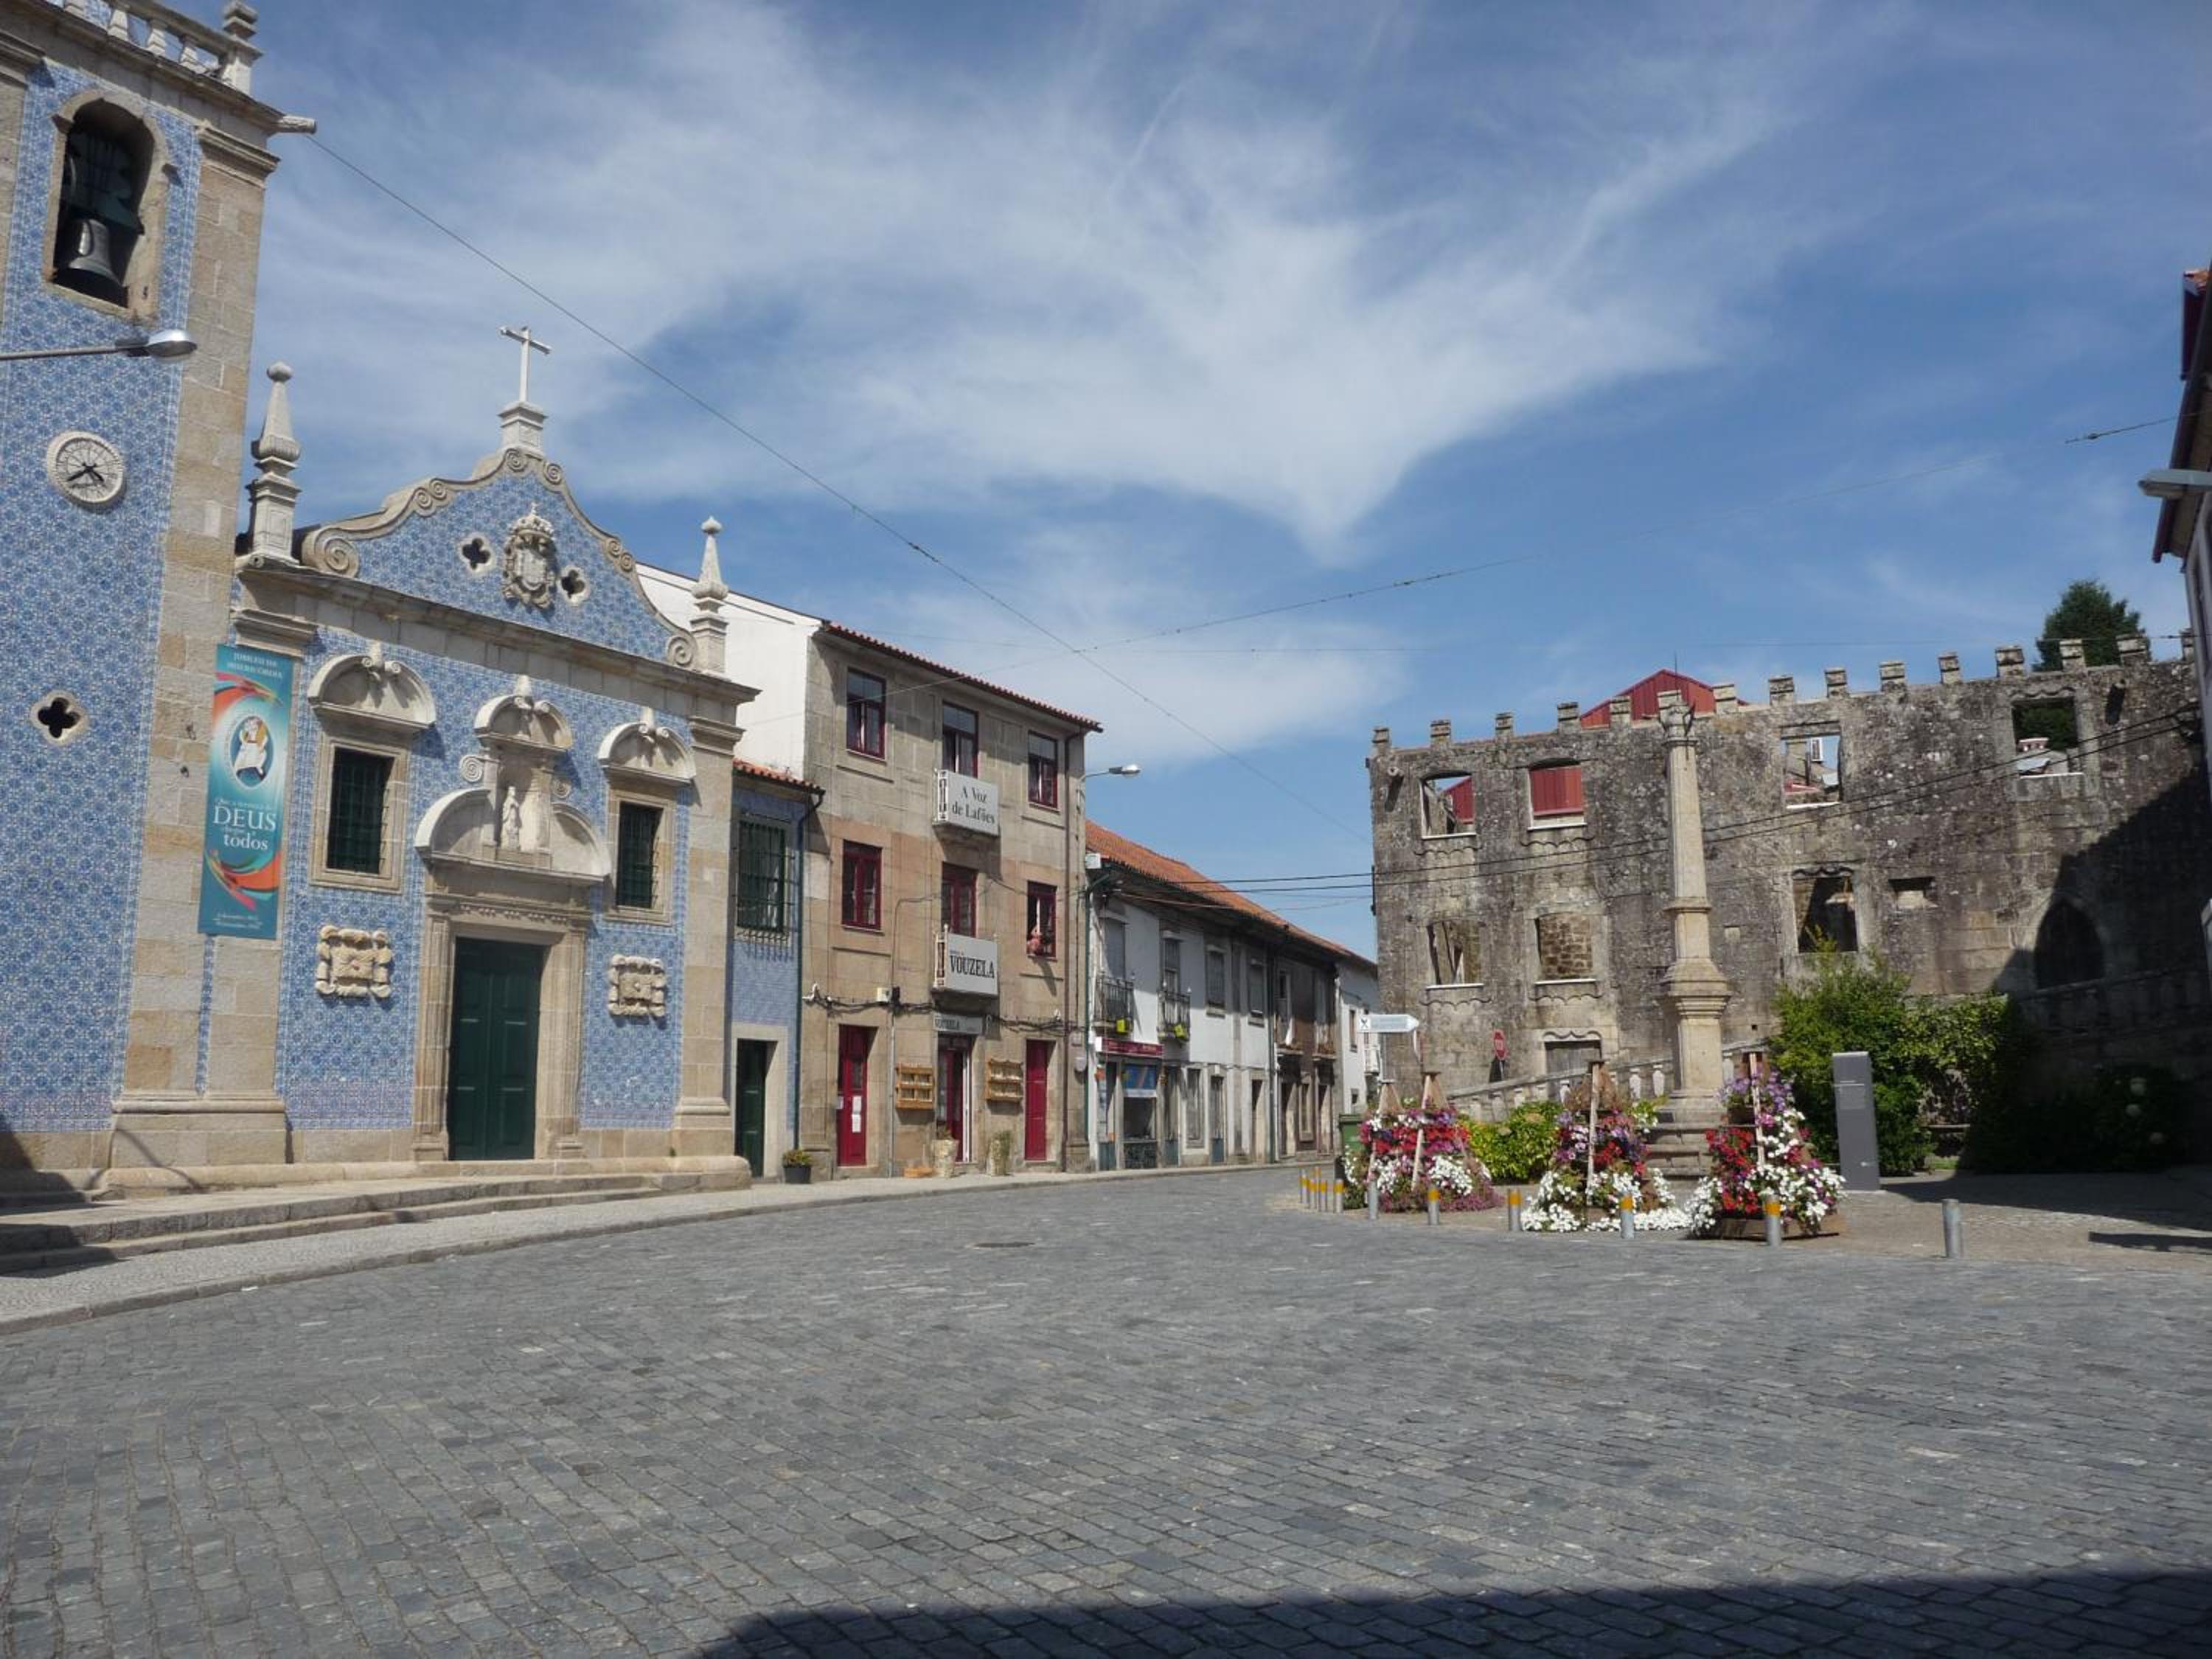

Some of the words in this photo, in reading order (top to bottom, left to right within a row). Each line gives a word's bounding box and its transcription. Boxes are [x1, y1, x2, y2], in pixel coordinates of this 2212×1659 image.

[972, 787, 988, 803] Voz
[952, 800, 964, 815] de
[212, 805, 276, 832] DEUS
[223, 832, 269, 850] todos
[950, 954, 995, 980] VOUZELA
